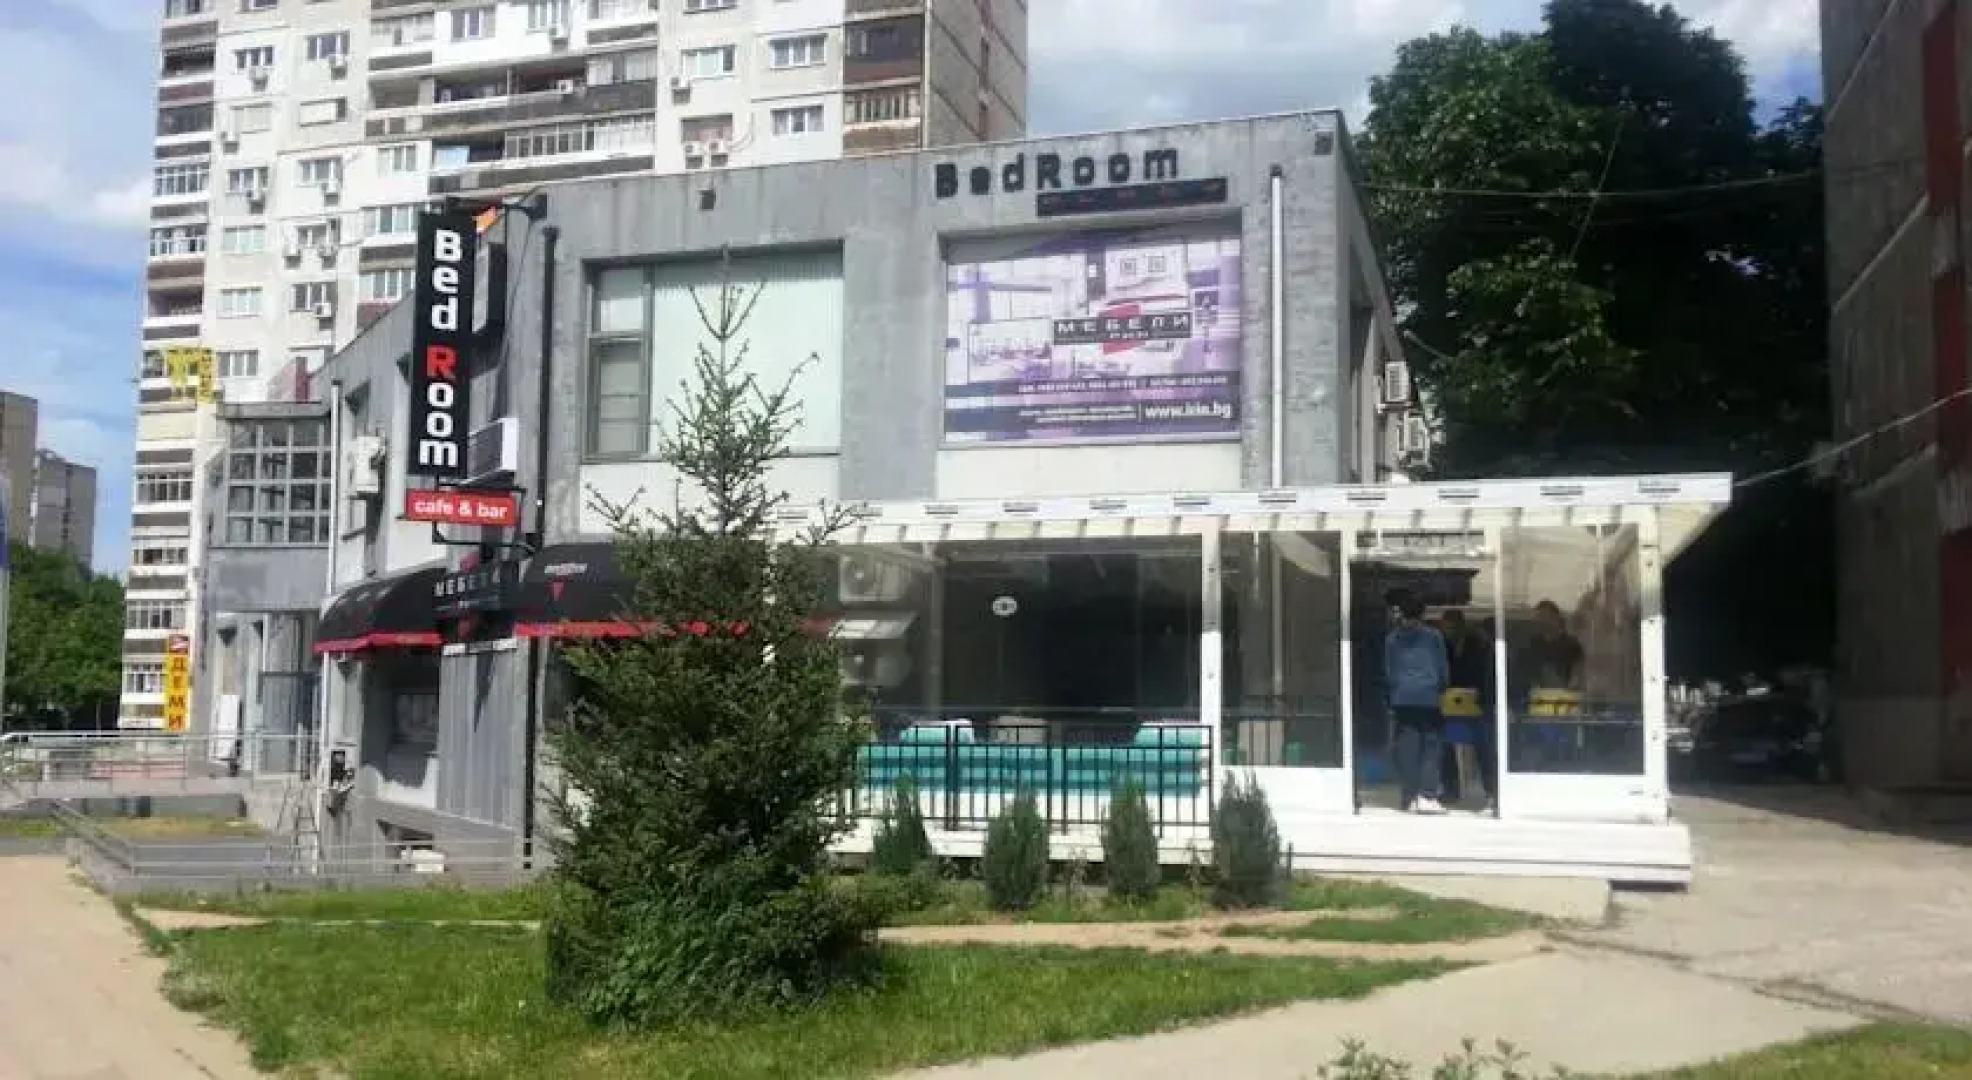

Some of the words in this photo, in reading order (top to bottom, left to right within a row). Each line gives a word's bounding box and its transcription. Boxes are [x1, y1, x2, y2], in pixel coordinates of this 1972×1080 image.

[431, 229, 462, 332] Bed
[419, 345, 458, 468] Room
[414, 498, 454, 515] cafe
[458, 500, 472, 516] &
[477, 502, 508, 518] bar
